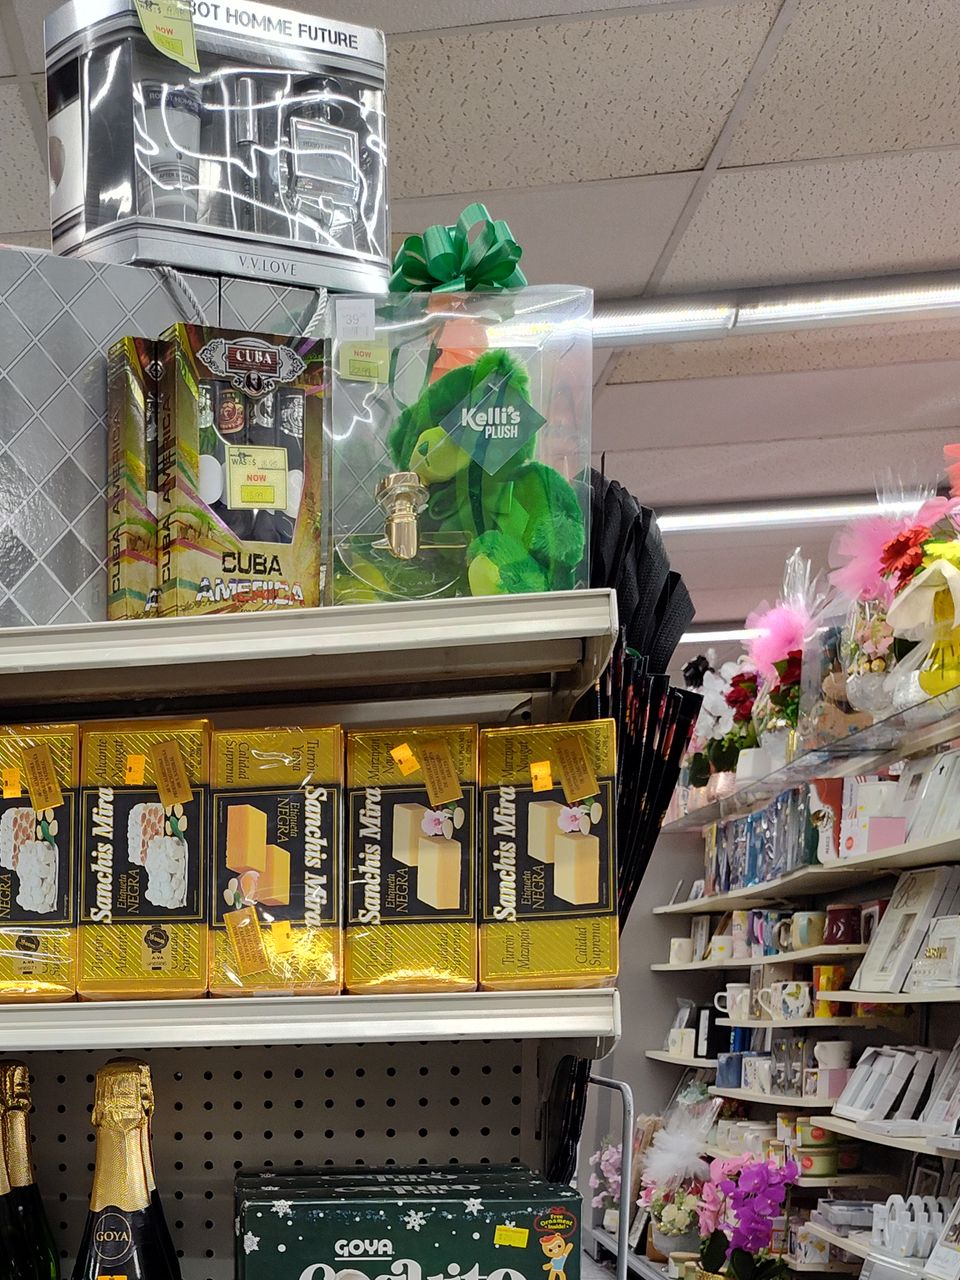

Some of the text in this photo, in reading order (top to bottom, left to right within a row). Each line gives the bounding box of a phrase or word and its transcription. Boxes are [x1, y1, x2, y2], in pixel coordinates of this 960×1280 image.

[226, 10, 358, 49] HOMME FUTURE
[239, 256, 297, 276] V.V.LOVE
[235, 350, 273, 365] CUBA
[354, 350, 371, 358] NOW
[462, 406, 521, 431] Kelli's
[485, 425, 518, 439] PLUSH
[246, 474, 267, 482] NOW
[112, 526, 122, 593] CUBA
[160, 514, 171, 584] CUBA
[222, 552, 282, 576] CUBA
[196, 577, 305, 607] AMERICA
[96, 739, 107, 780] Alicante
[238, 742, 249, 780] Calidad
[277, 797, 289, 843] NEGRA
[289, 802, 300, 838] Etiqueta
[90, 787, 115, 924] Sanchis Mira
[304, 785, 327, 927] Sanchis Mira
[358, 787, 382, 925] Sanchis Mira
[493, 786, 517, 922] Sanchis Mira
[0, 874, 11, 919] NEGRA
[117, 874, 127, 909] Etiqueta
[128, 869, 140, 914] NEGRA
[385, 874, 396, 908] Etiqueta
[396, 868, 409, 913] NEGRA
[521, 870, 531, 905] Etiqueta
[533, 864, 545, 910] NEGRA
[502, 934, 515, 965] Turrón
[518, 927, 530, 969] Mazapán
[576, 926, 588, 965] Calidad
[590, 922, 601, 966] Suprema
[96, 1231, 129, 1243] GOYA
[334, 1239, 396, 1256] GOYA
